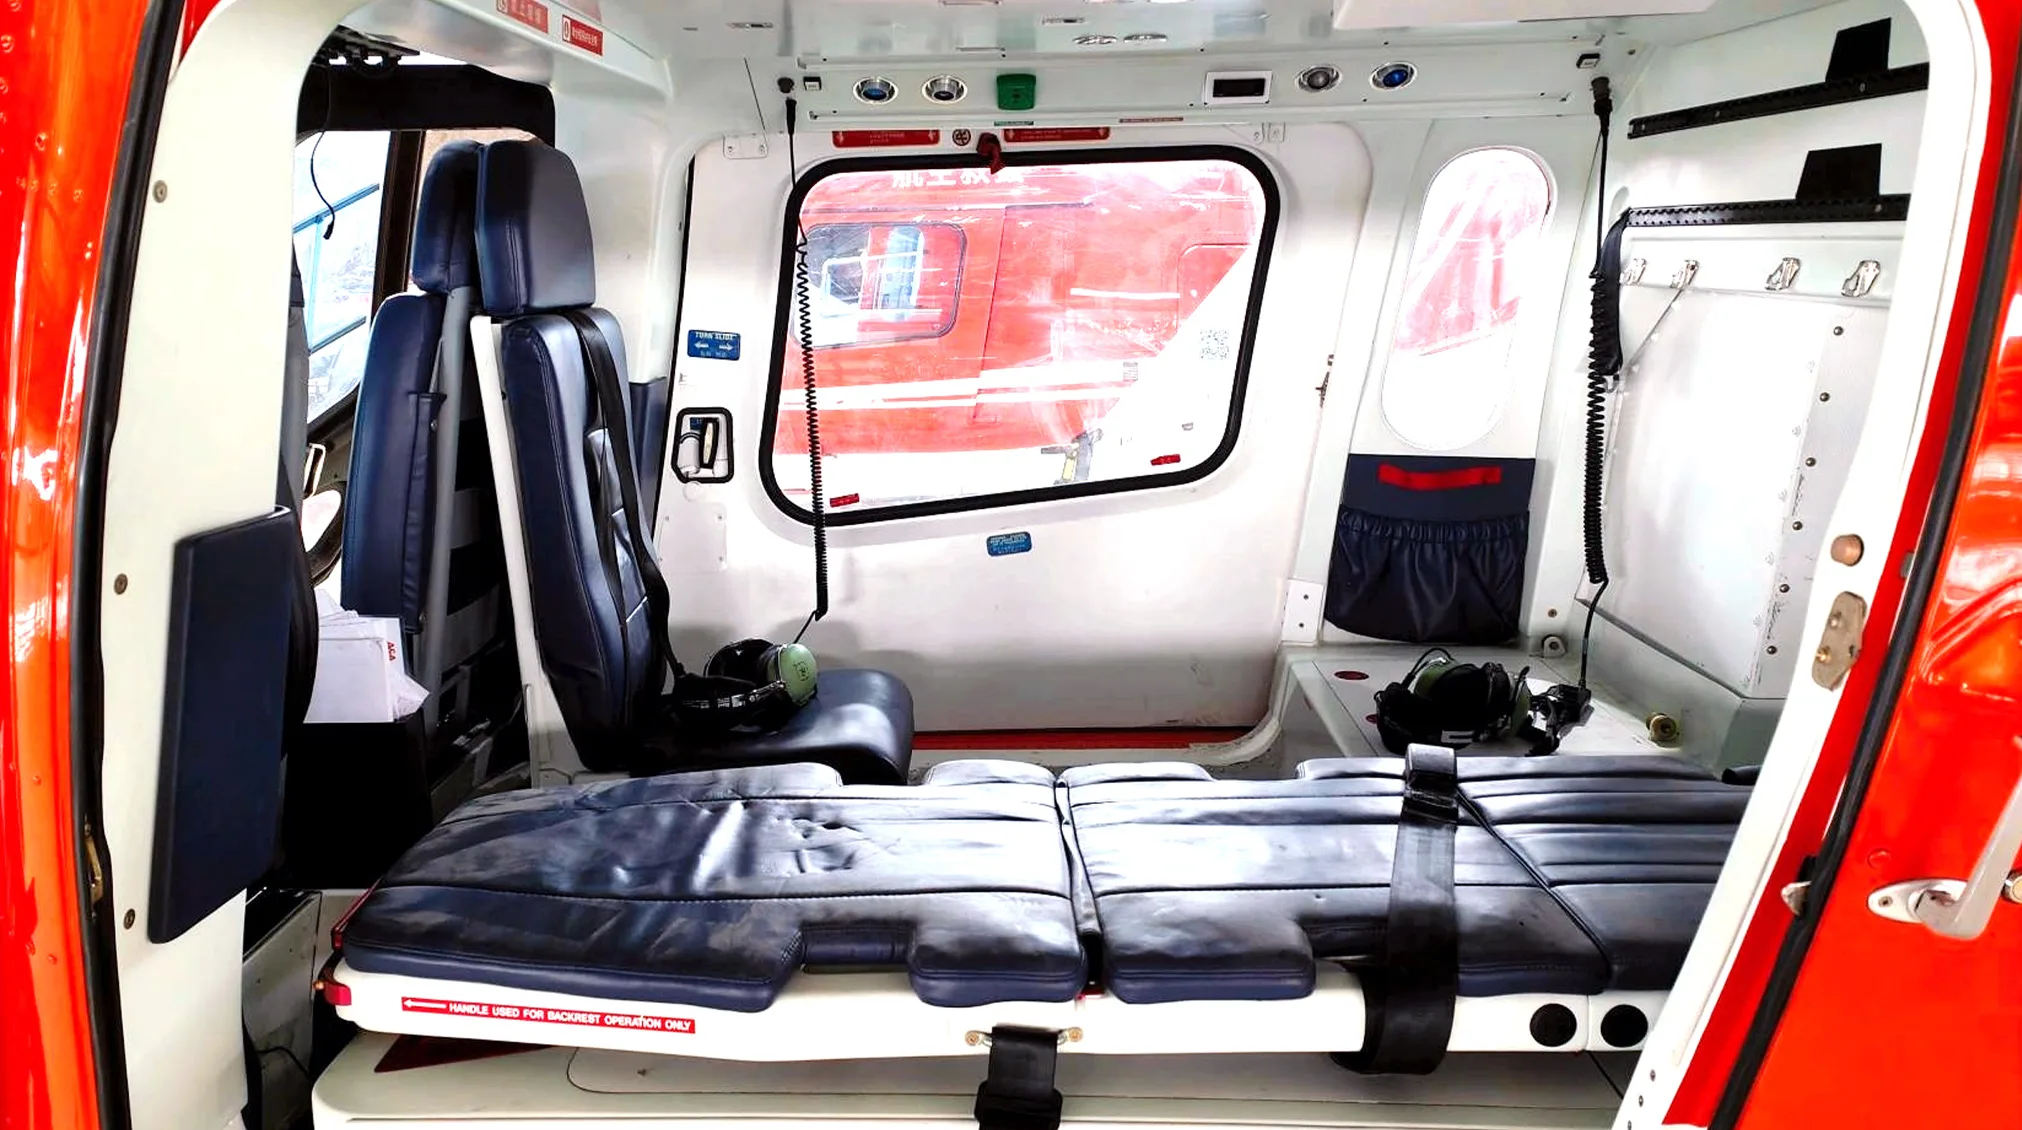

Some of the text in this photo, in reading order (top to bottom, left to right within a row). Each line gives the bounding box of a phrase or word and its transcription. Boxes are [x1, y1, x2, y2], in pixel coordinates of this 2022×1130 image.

[449, 1003, 691, 1031] HANDLE USED FOR BACKREST OPERATION ONLY
